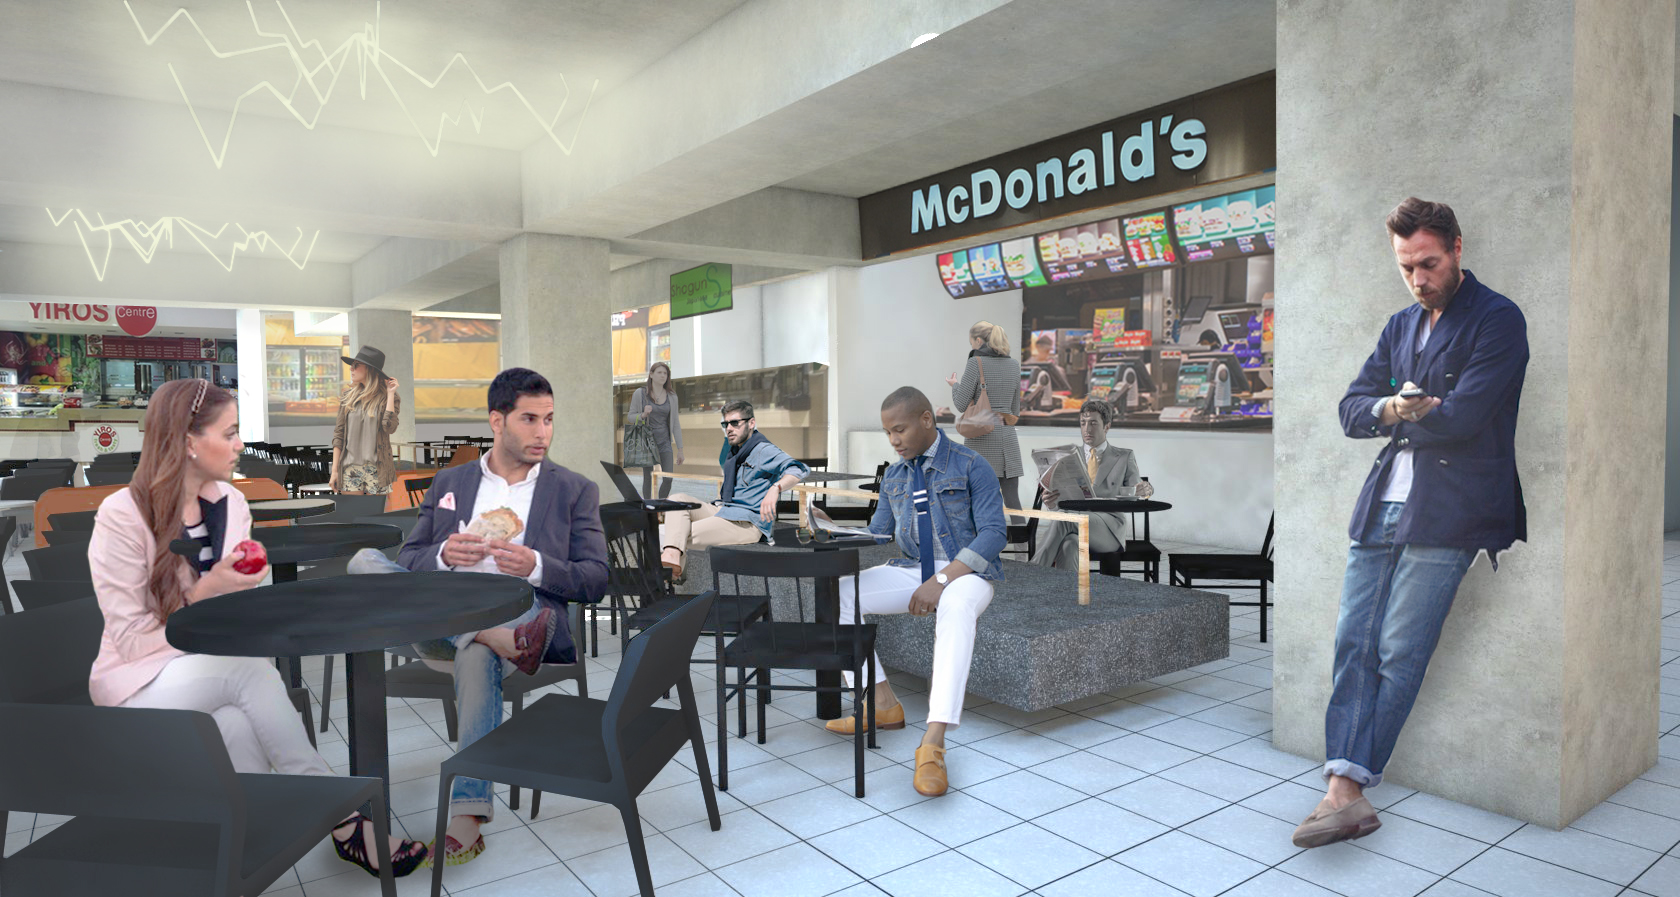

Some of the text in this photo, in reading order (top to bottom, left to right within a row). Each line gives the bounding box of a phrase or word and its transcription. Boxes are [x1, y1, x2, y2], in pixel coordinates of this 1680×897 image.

[911, 114, 1207, 234] McDonald's
[671, 278, 708, 297] Shogun
[28, 302, 155, 322] YIROS Centre
[93, 425, 117, 438] YIROS
